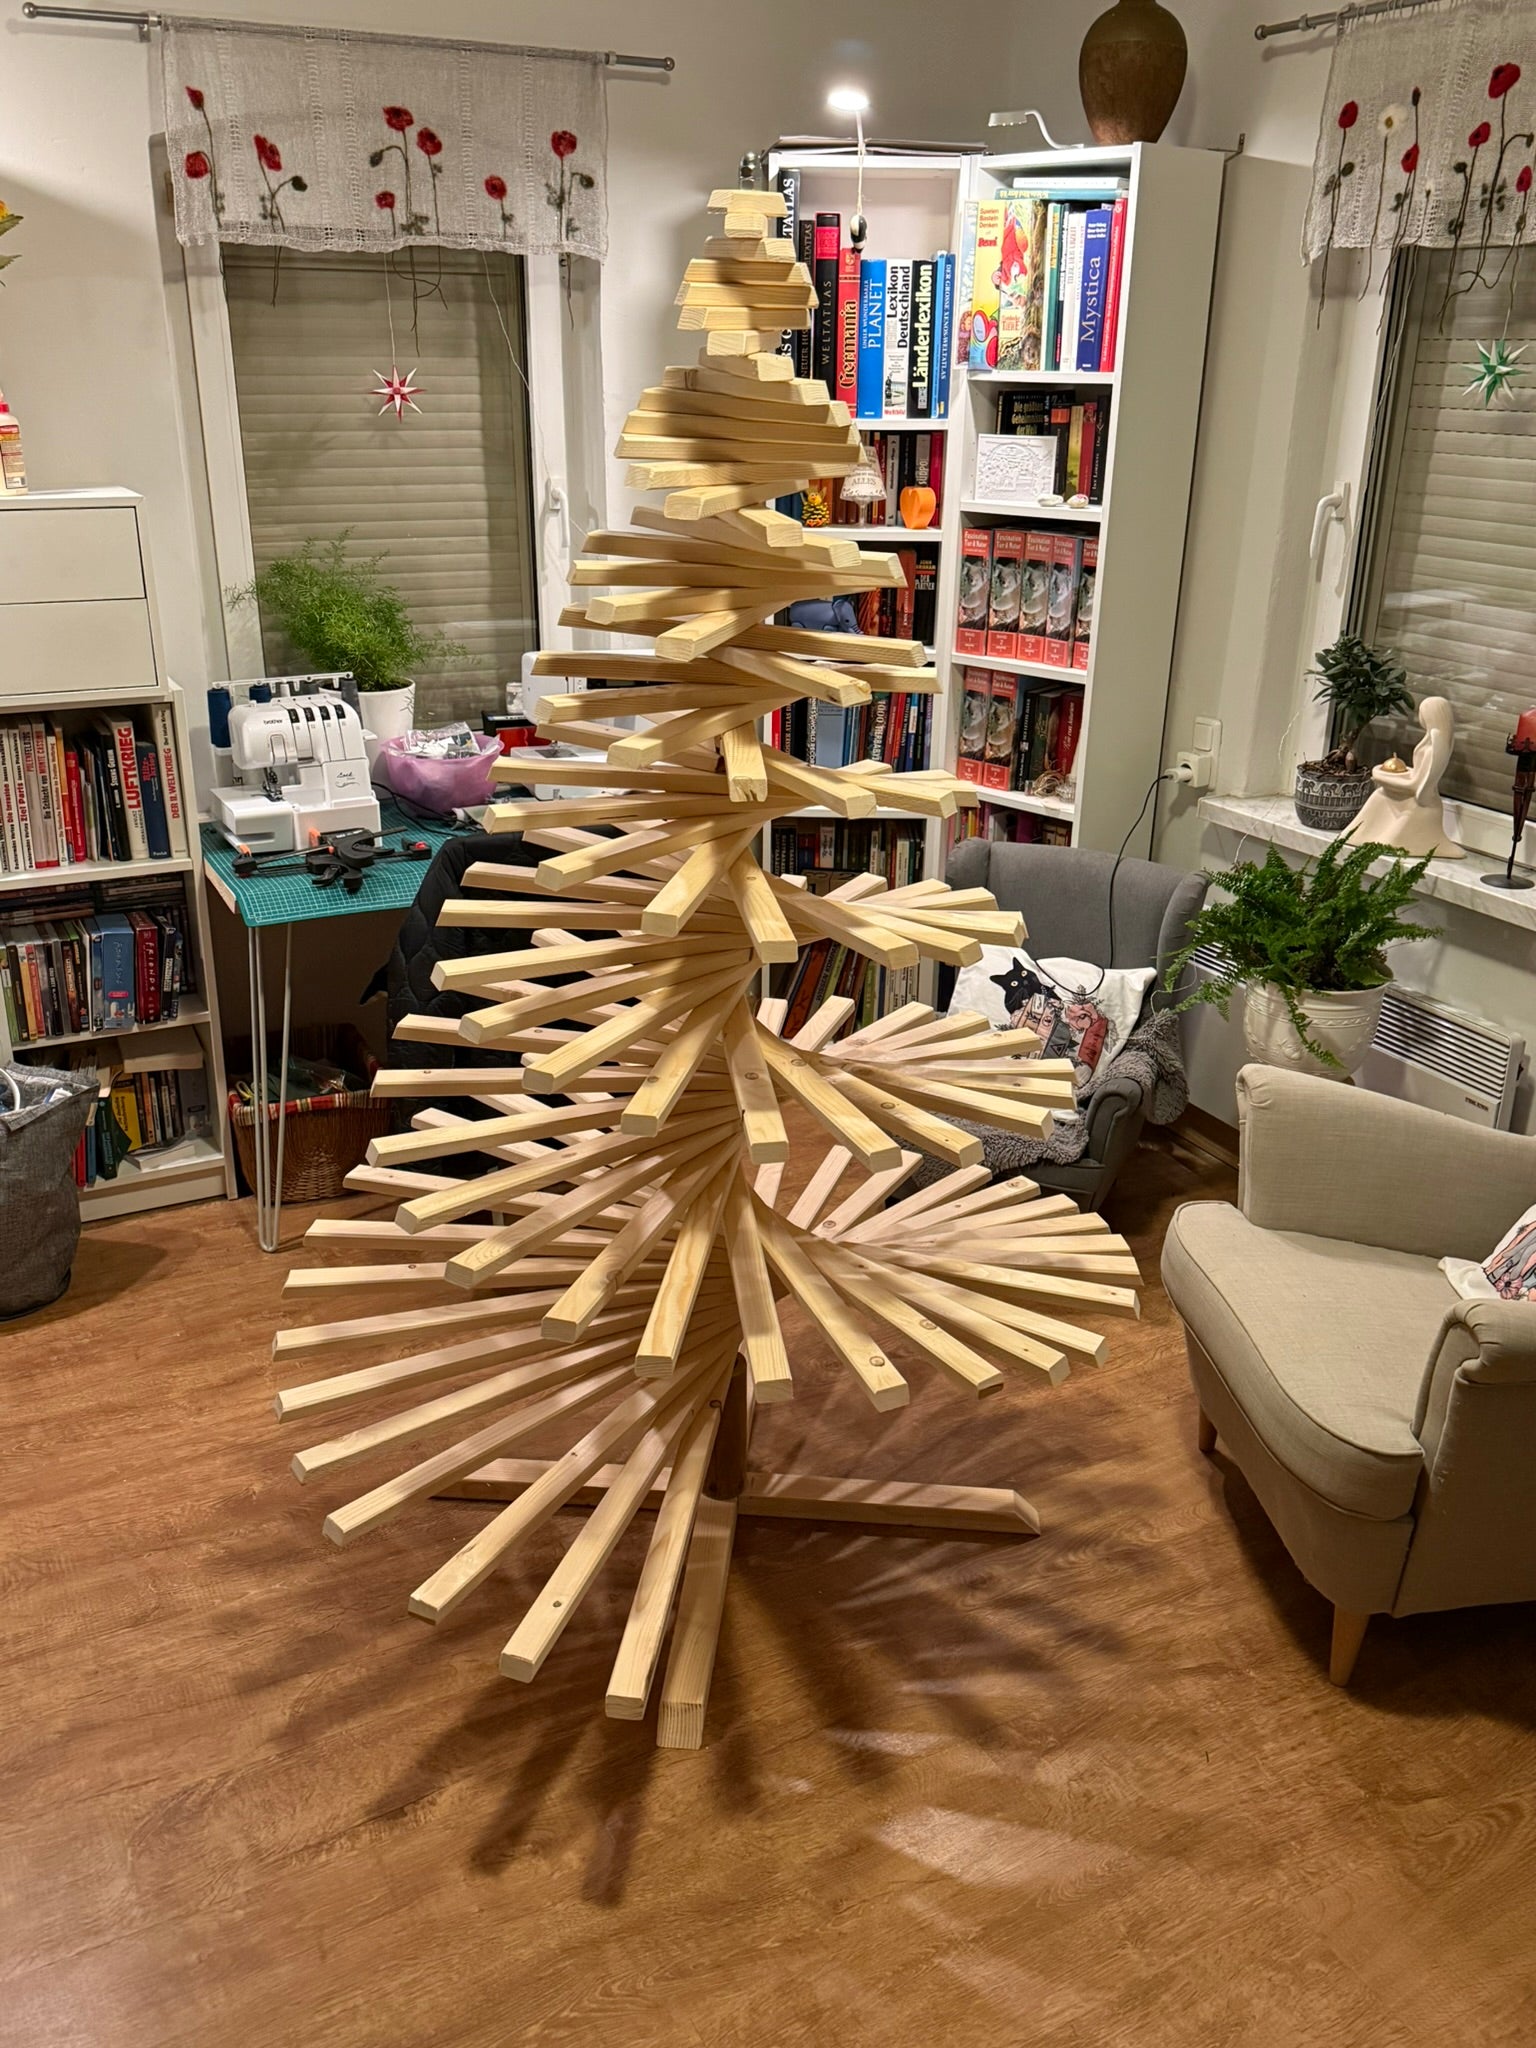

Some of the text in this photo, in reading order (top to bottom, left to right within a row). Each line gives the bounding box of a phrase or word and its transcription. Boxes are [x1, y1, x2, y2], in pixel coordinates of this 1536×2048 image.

[781, 178, 794, 357] RS G LTALAS
[803, 224, 812, 265] ELTATLAS
[869, 279, 883, 348] PLANET
[887, 266, 899, 318] Lexikon
[897, 266, 910, 348] Deutschland
[1080, 256, 1101, 343] Mystica
[801, 330, 809, 345] HIS
[822, 280, 832, 365] WELTATLAS
[840, 300, 857, 388] Germania
[912, 265, 932, 387] Länderlexikon
[941, 312, 949, 380] XENOS-WELTATLAS
[852, 477, 876, 485] ALLES
[876, 700, 885, 723] 1000
[37, 755, 47, 774] MONTE
[117, 727, 141, 809] LUFTKRIEG
[148, 752, 156, 776] krieg
[164, 748, 176, 794] WELTKRIEG
[4, 783, 12, 811] Invasion
[17, 782, 26, 804] Paris
[20, 806, 28, 822] Ziel
[172, 803, 180, 818] DER
[144, 942, 155, 992] FRIENDS
